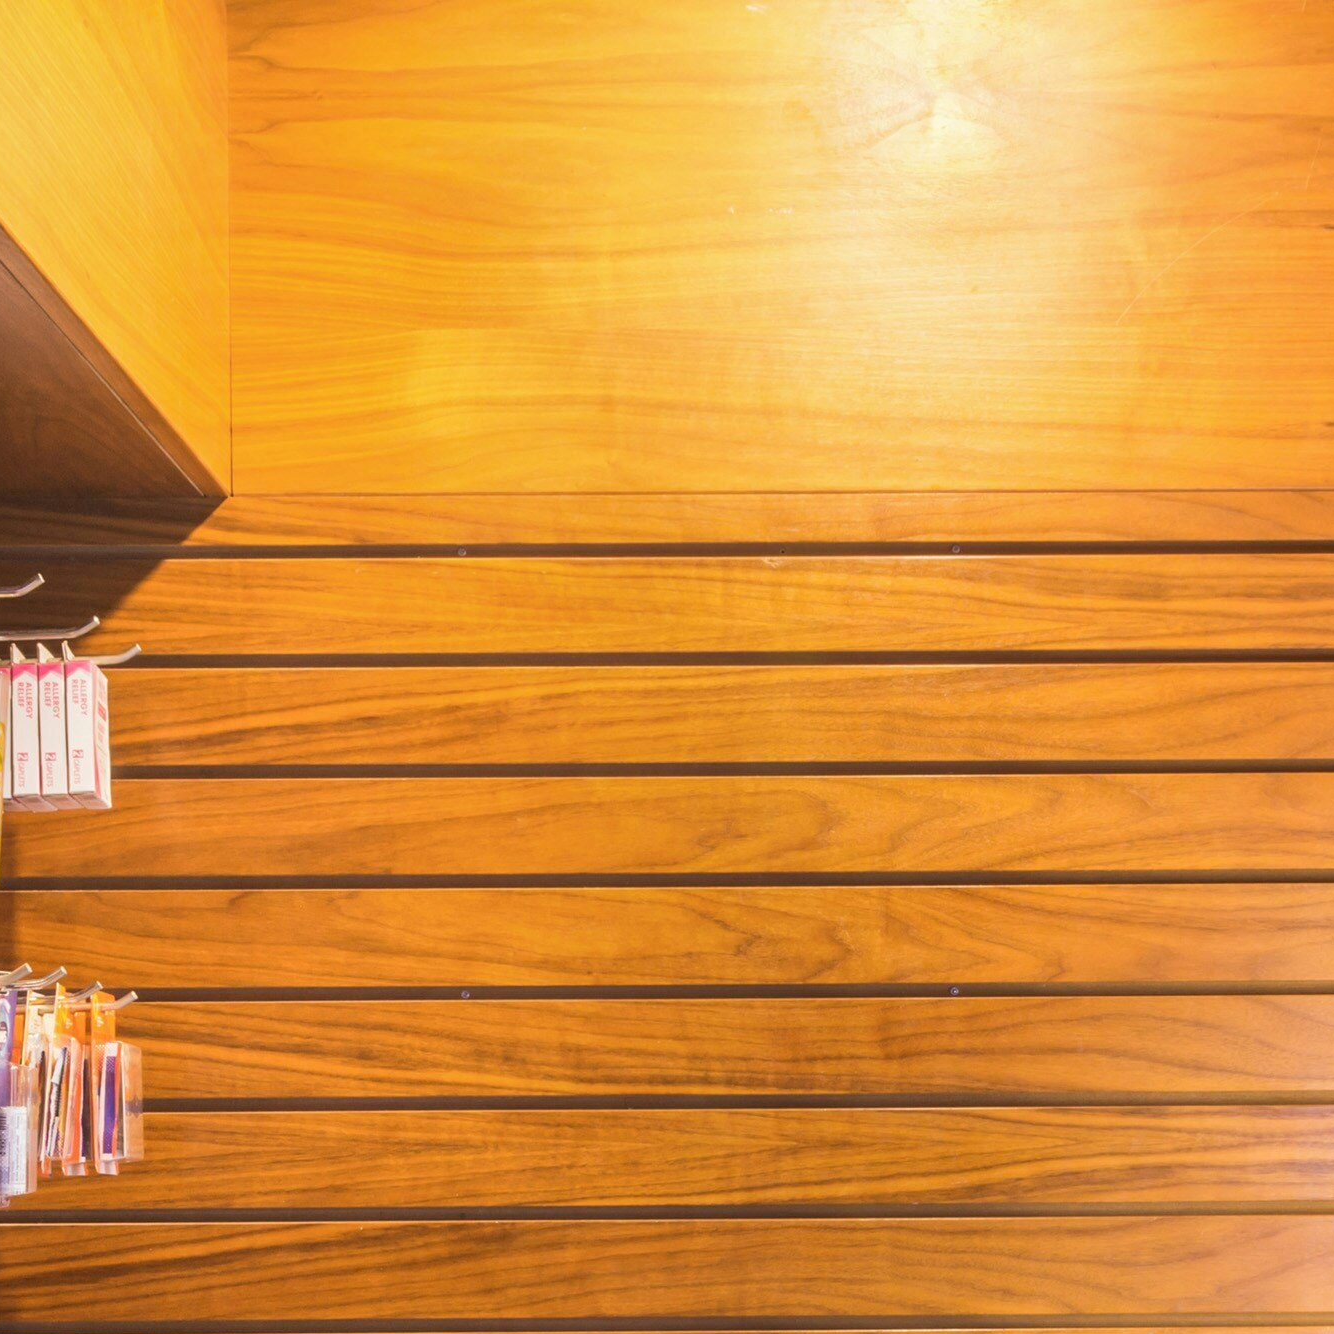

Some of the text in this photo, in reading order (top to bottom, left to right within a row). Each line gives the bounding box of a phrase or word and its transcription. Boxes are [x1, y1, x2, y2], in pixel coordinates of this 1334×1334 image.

[16, 681, 25, 708] RELIEF
[25, 681, 34, 719] ALLERGY
[51, 681, 60, 719] ALLERGY
[72, 678, 80, 705] RELIEF
[79, 678, 87, 716] ALLERGY
